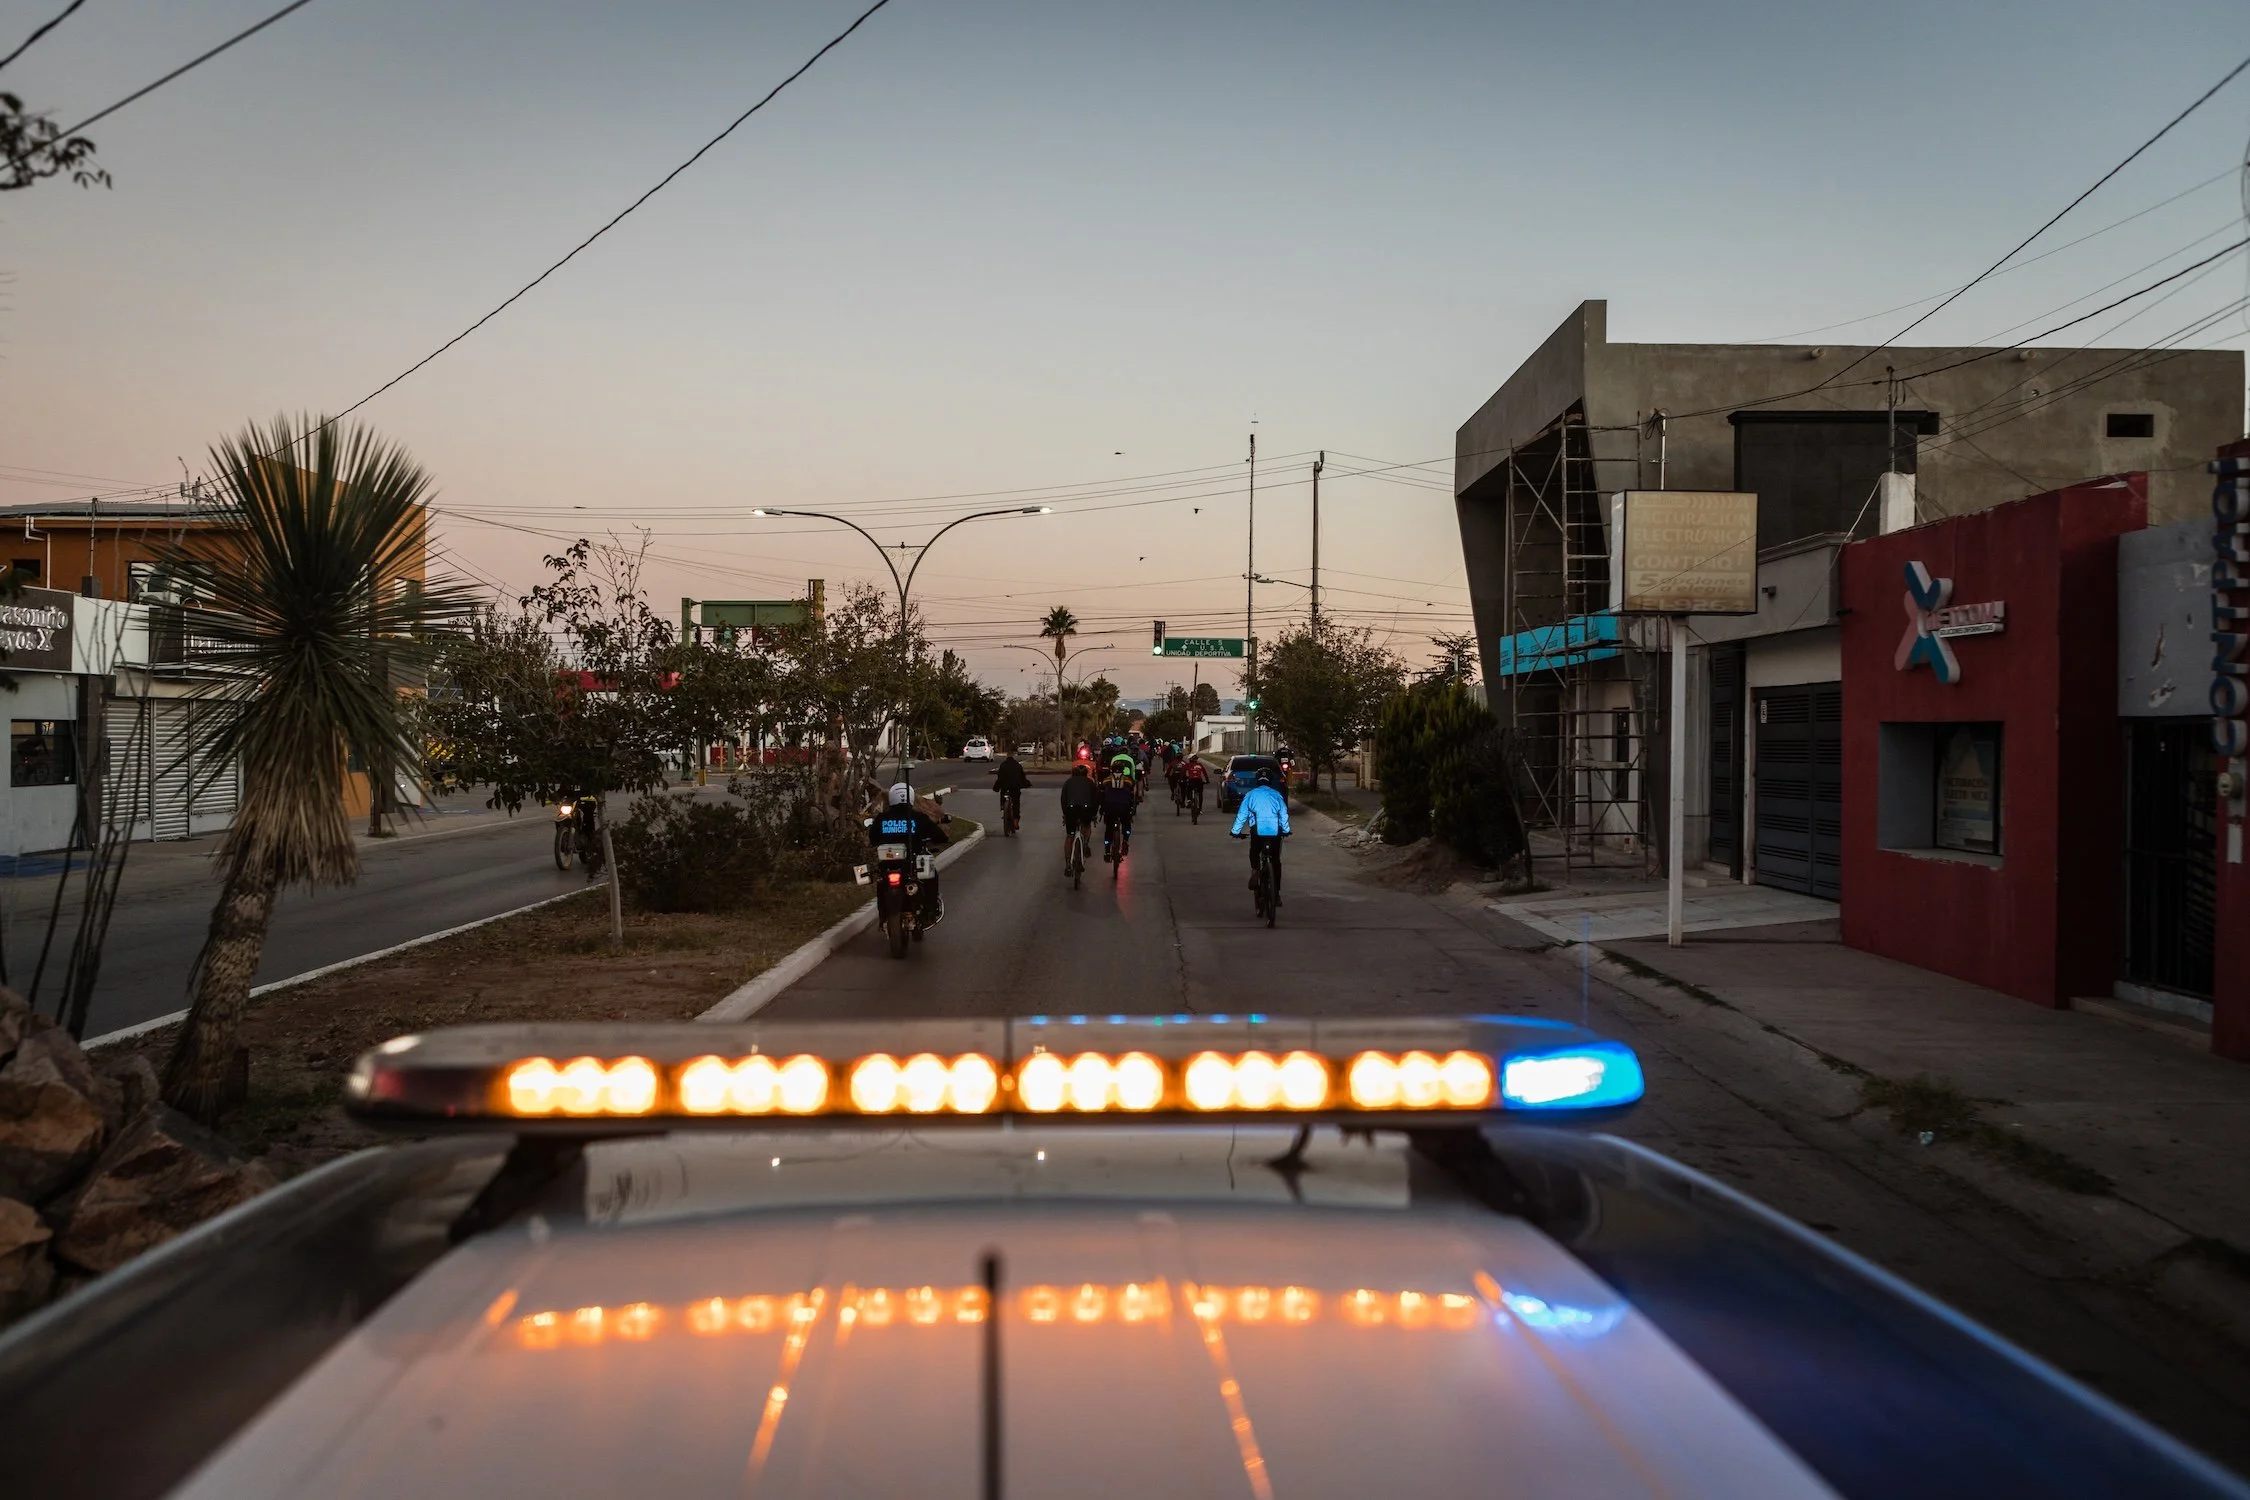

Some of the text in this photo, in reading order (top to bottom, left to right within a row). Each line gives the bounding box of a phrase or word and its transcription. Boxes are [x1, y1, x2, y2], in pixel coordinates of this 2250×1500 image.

[1636, 573, 1746, 588] 5 opciones
[37, 628, 55, 651] X
[882, 826, 916, 834] MUNICIPL
